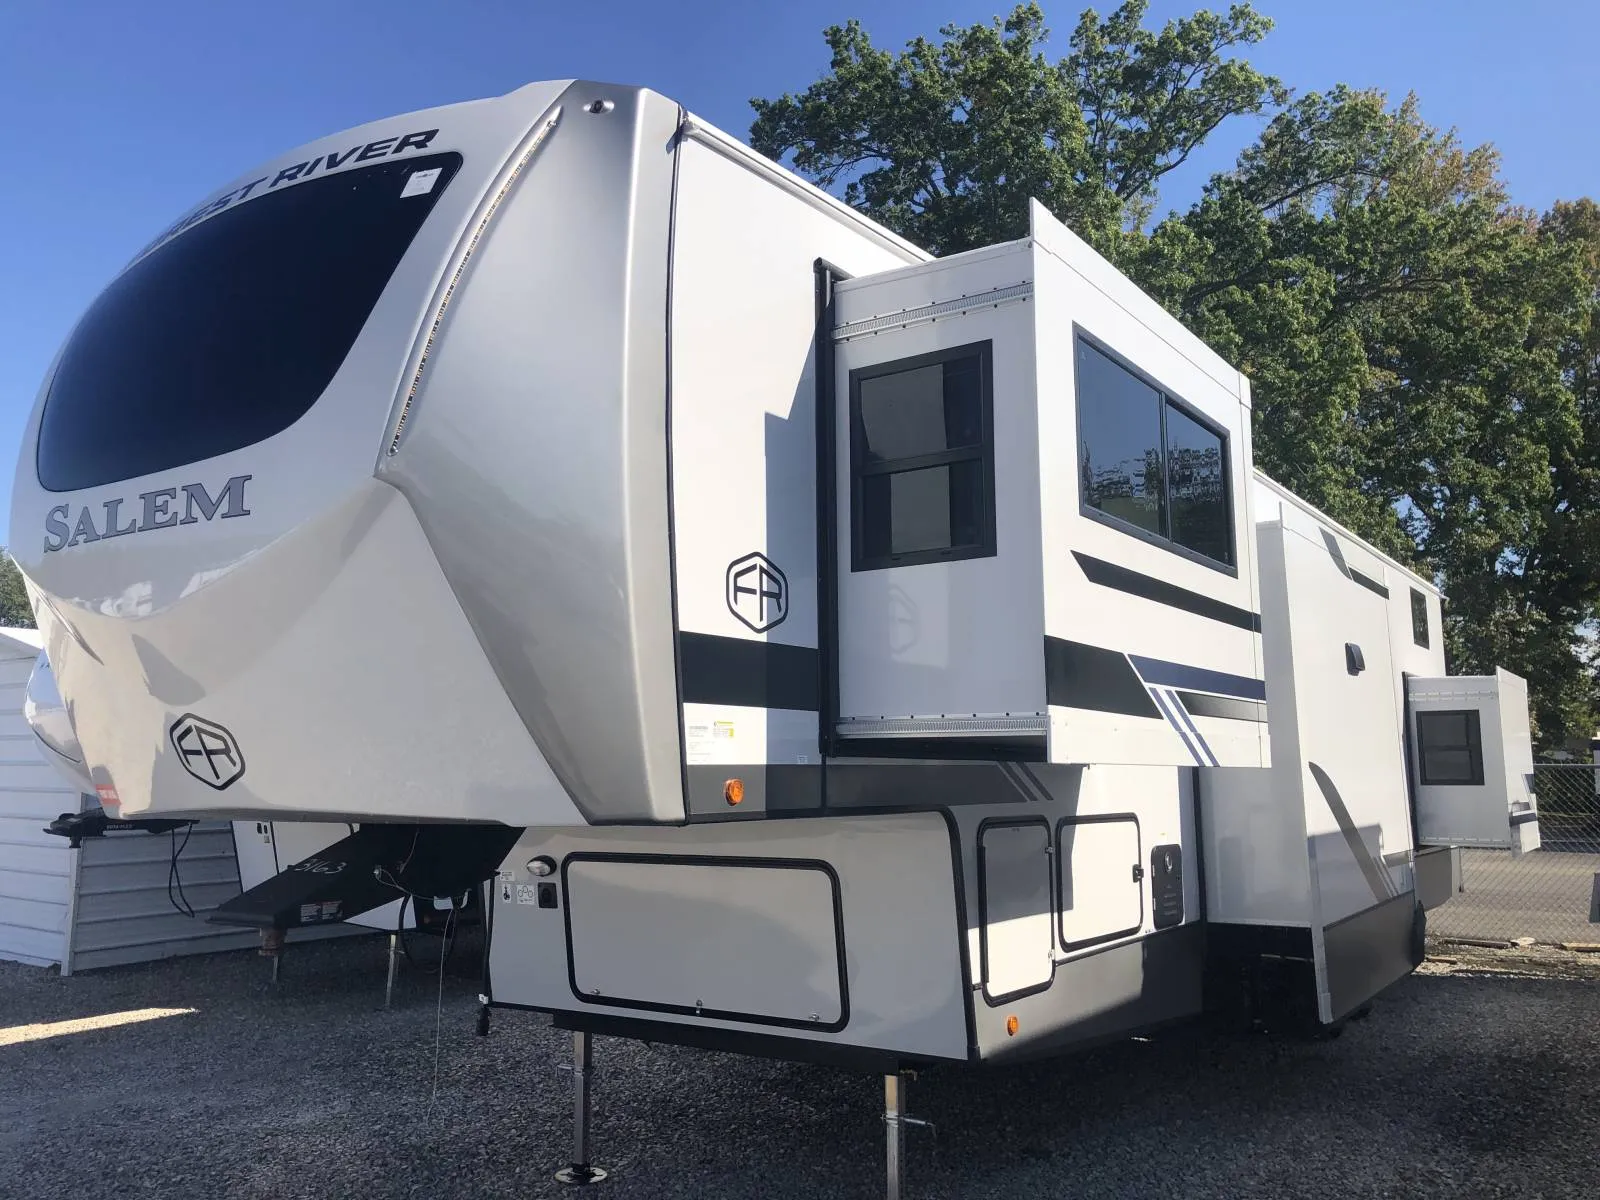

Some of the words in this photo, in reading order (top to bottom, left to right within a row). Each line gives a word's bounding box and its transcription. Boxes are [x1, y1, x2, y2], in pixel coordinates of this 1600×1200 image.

[269, 128, 439, 188] RIVER
[44, 474, 252, 553] SALEM
[733, 563, 782, 622] FR
[177, 724, 237, 780] FR
